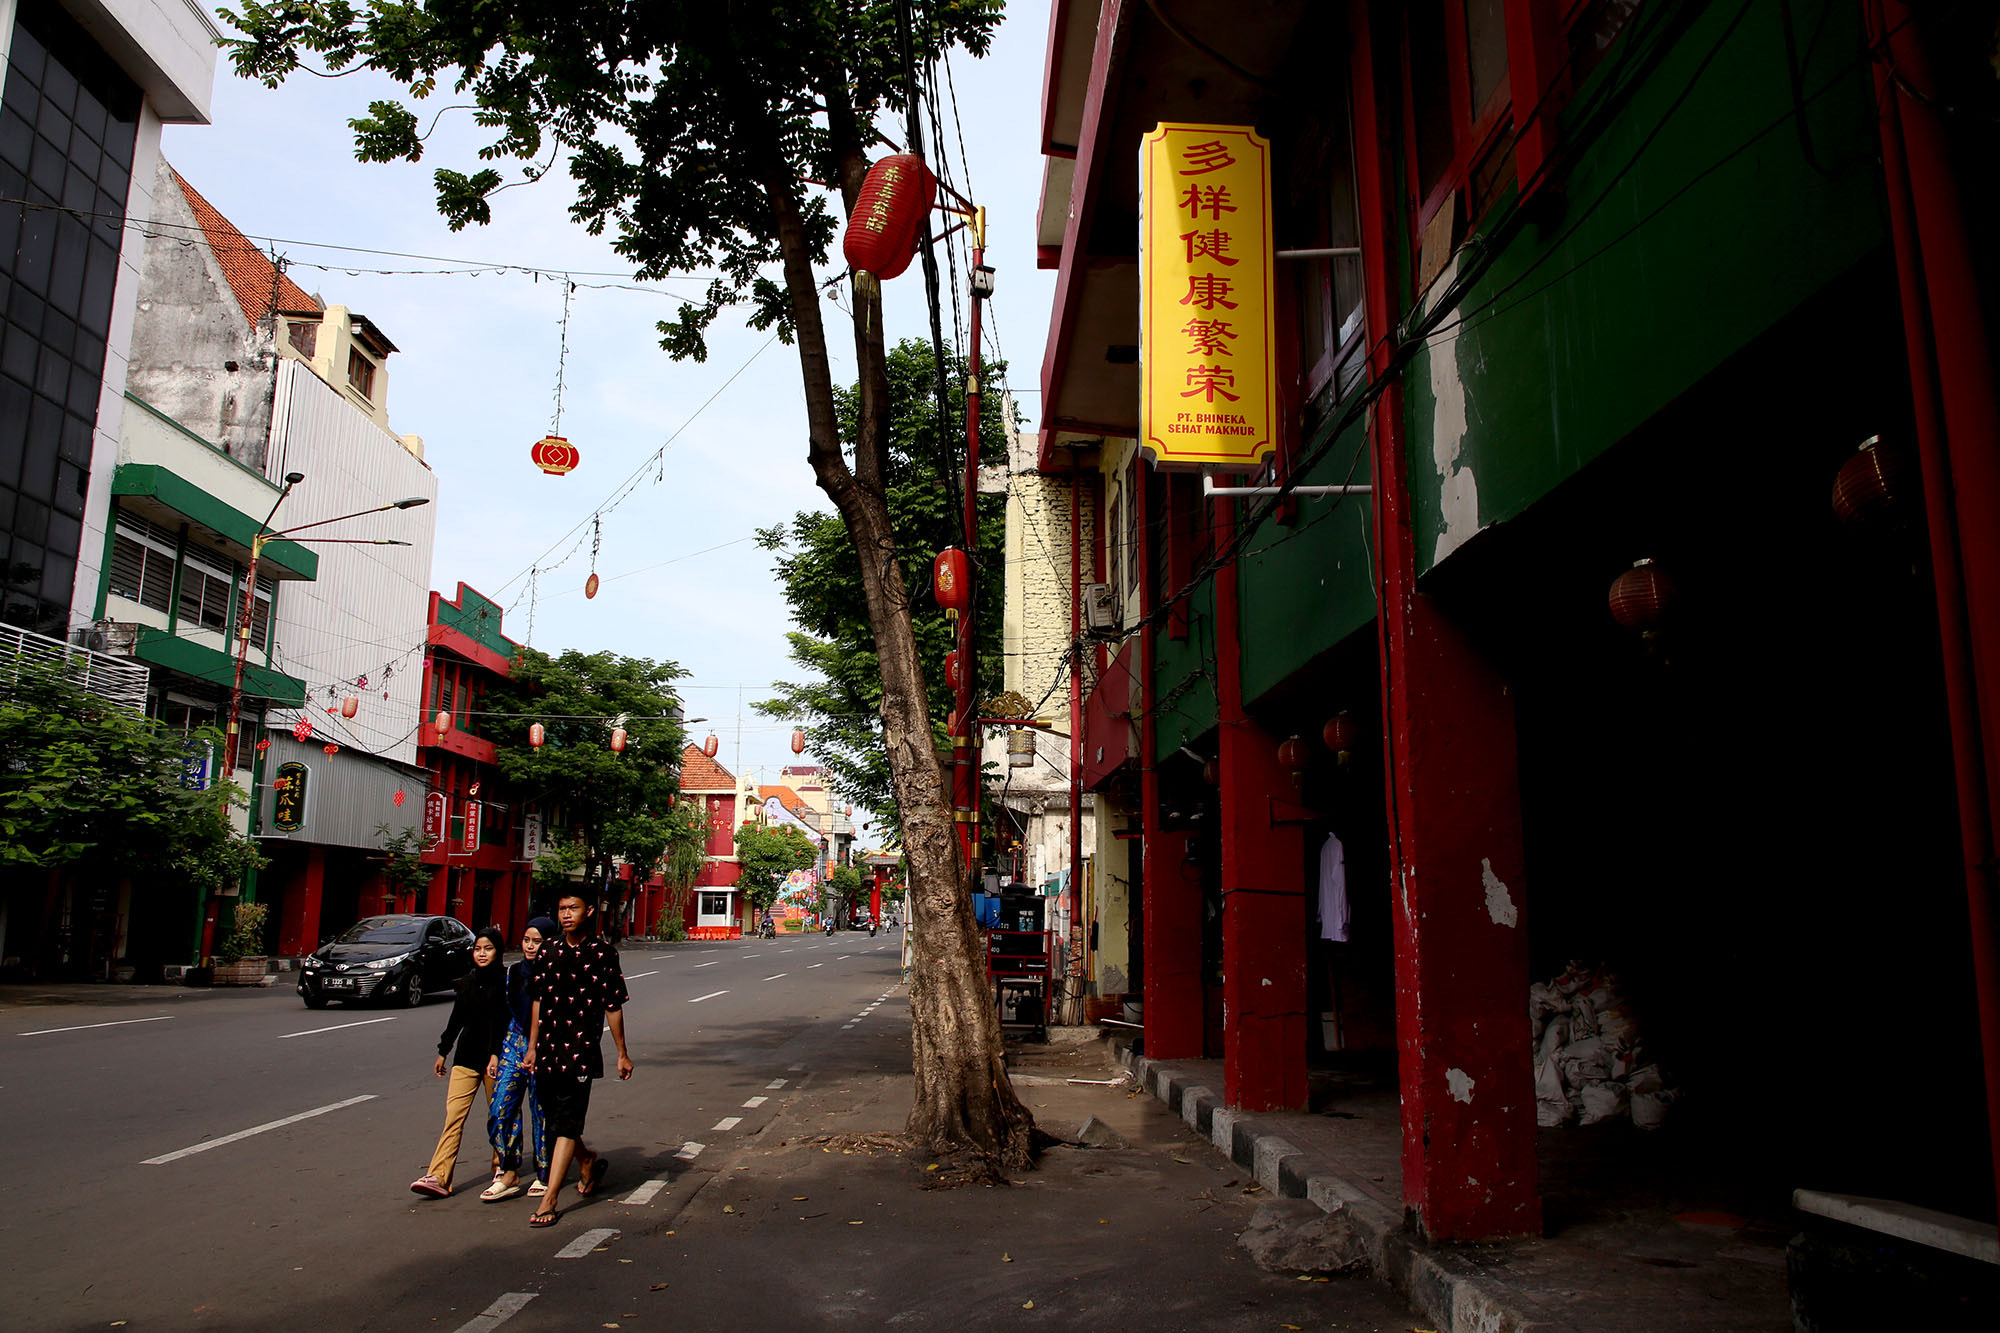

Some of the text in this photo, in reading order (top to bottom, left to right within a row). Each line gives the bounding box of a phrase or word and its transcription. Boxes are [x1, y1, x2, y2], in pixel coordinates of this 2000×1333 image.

[1179, 140, 1240, 403] 多样健康繁荣
[1177, 412, 1246, 425] PT. BHINEKA
[1168, 423, 1255, 436] SEHAT MAKMUR
